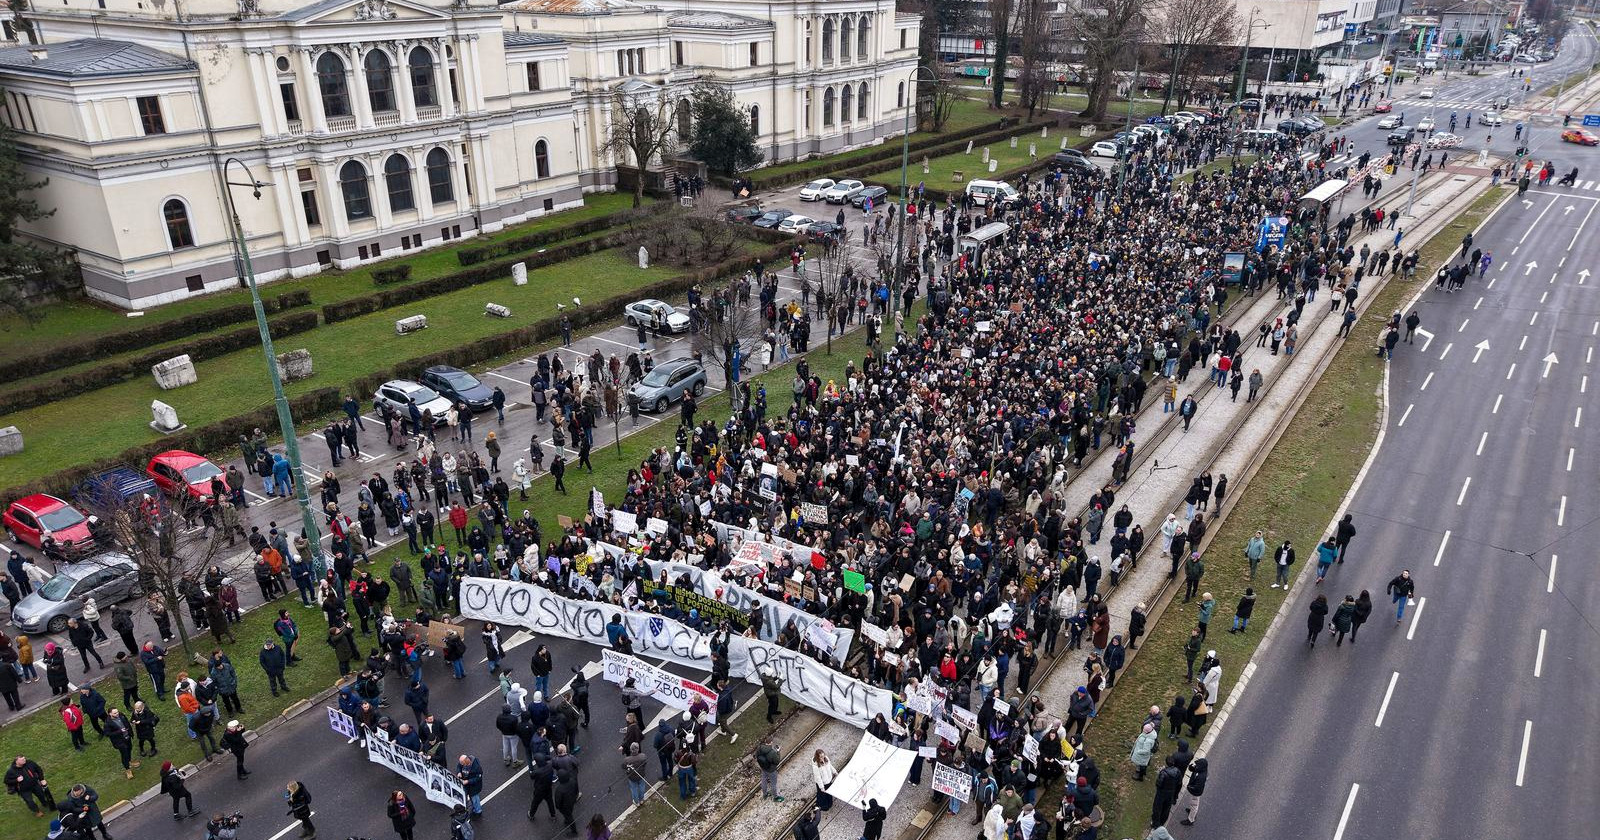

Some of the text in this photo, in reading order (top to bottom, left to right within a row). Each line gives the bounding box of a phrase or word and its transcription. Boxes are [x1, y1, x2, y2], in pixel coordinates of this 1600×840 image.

[465, 582, 531, 616] OVO
[535, 597, 605, 639] SMO
[623, 617, 709, 660] MOGL
[824, 673, 877, 721] MI
[658, 671, 680, 686] ZBOG
[654, 679, 688, 700] ZBOG
